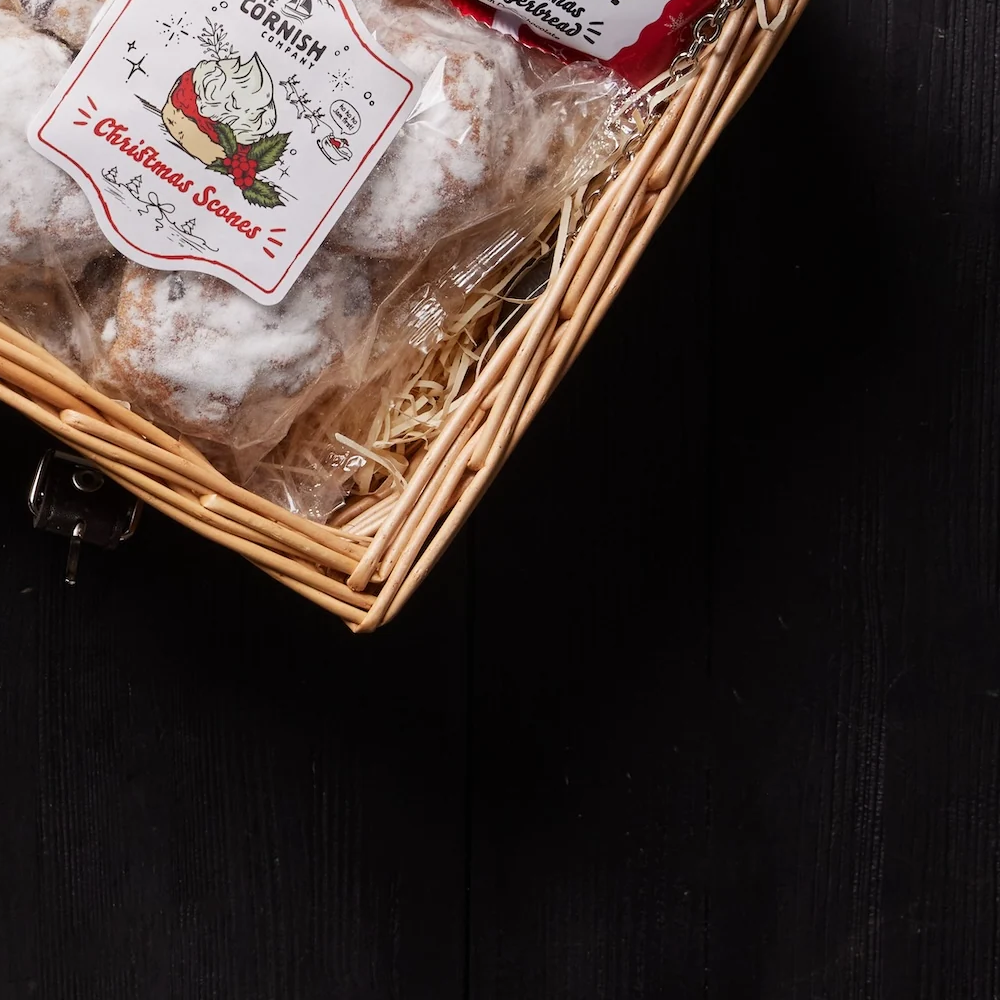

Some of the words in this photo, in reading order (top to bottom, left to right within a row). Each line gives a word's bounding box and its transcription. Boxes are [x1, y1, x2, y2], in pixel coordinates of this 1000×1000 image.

[261, 31, 315, 70] COMPANY
[94, 117, 194, 193] Christmas
[193, 185, 262, 239] Scones
